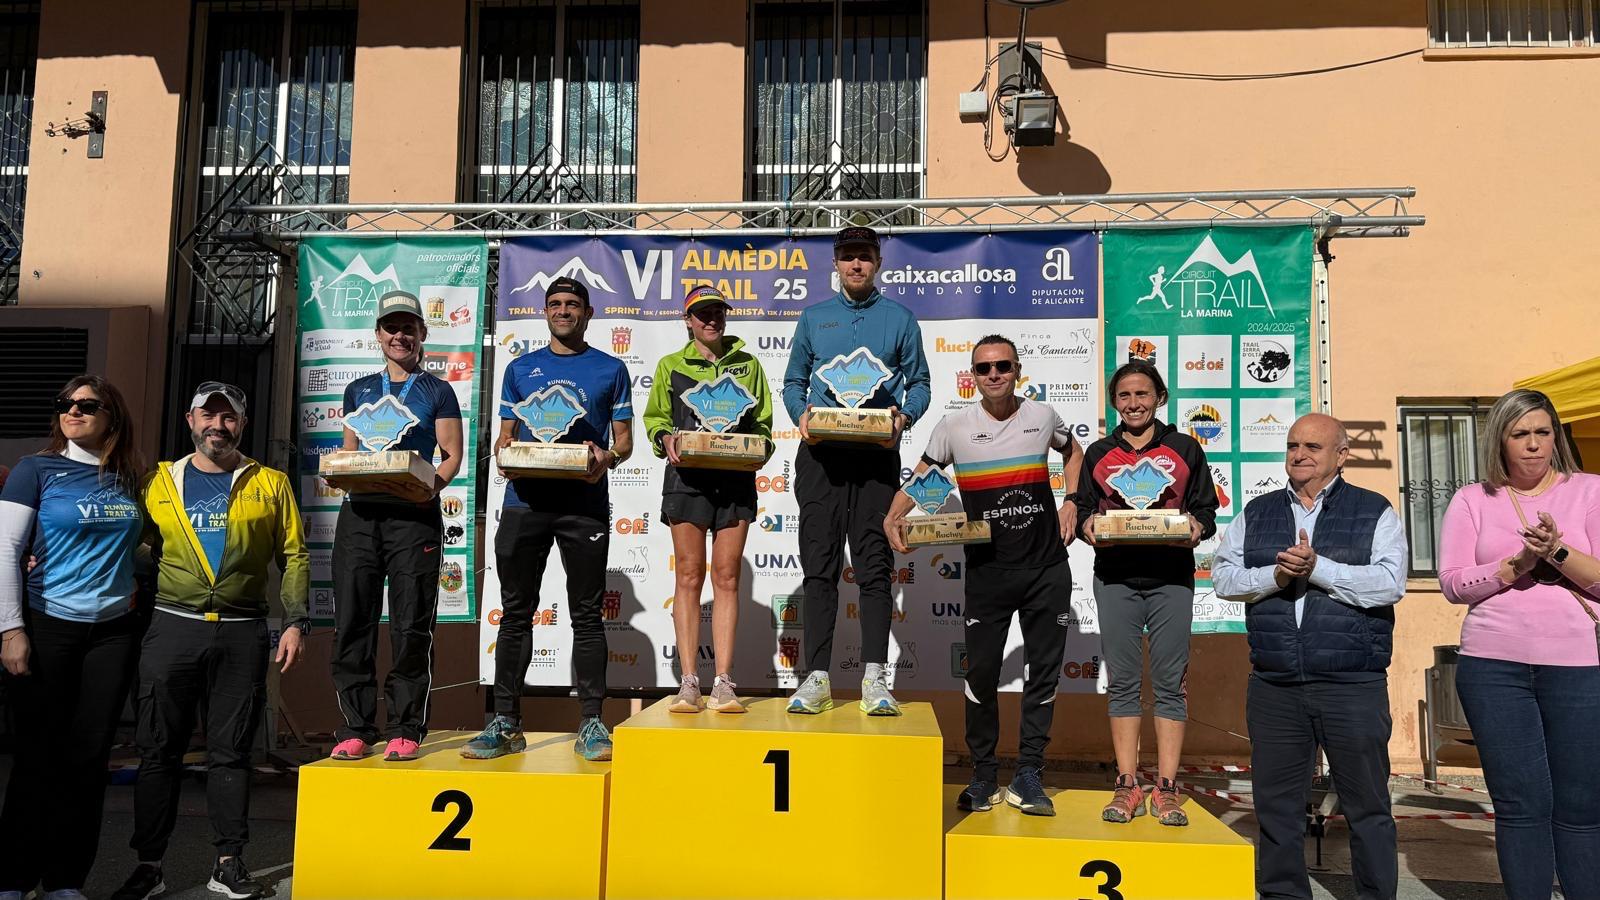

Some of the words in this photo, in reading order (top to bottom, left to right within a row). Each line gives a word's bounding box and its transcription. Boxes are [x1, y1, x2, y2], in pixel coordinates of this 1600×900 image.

[416, 253, 480, 263] patrocinadors
[681, 244, 808, 271] ALMÈDIA
[622, 250, 672, 300] VI
[881, 264, 1016, 284] caixacallosa
[1182, 270, 1216, 278] CIRCUIT
[774, 278, 808, 300] 25
[881, 284, 1016, 294] FUNDACIÓ
[1032, 288, 1084, 296] DIPUTACIÓN
[1172, 280, 1266, 308] TRAIL
[328, 286, 392, 310] TRA
[1196, 309, 1233, 317] MARINA
[1247, 323, 1295, 332] 2024/2025
[936, 337, 975, 352] Ruch
[423, 355, 466, 371] jaume
[547, 379, 576, 387] RUNNING
[710, 441, 737, 451] Ruchey
[983, 504, 1044, 520] ESPINOSA
[1126, 522, 1157, 532] Ruchey
[606, 565, 644, 573] anterella
[609, 650, 638, 666] hey
[762, 750, 790, 812] 1
[428, 790, 474, 852] 2
[1078, 860, 1124, 900] 3
